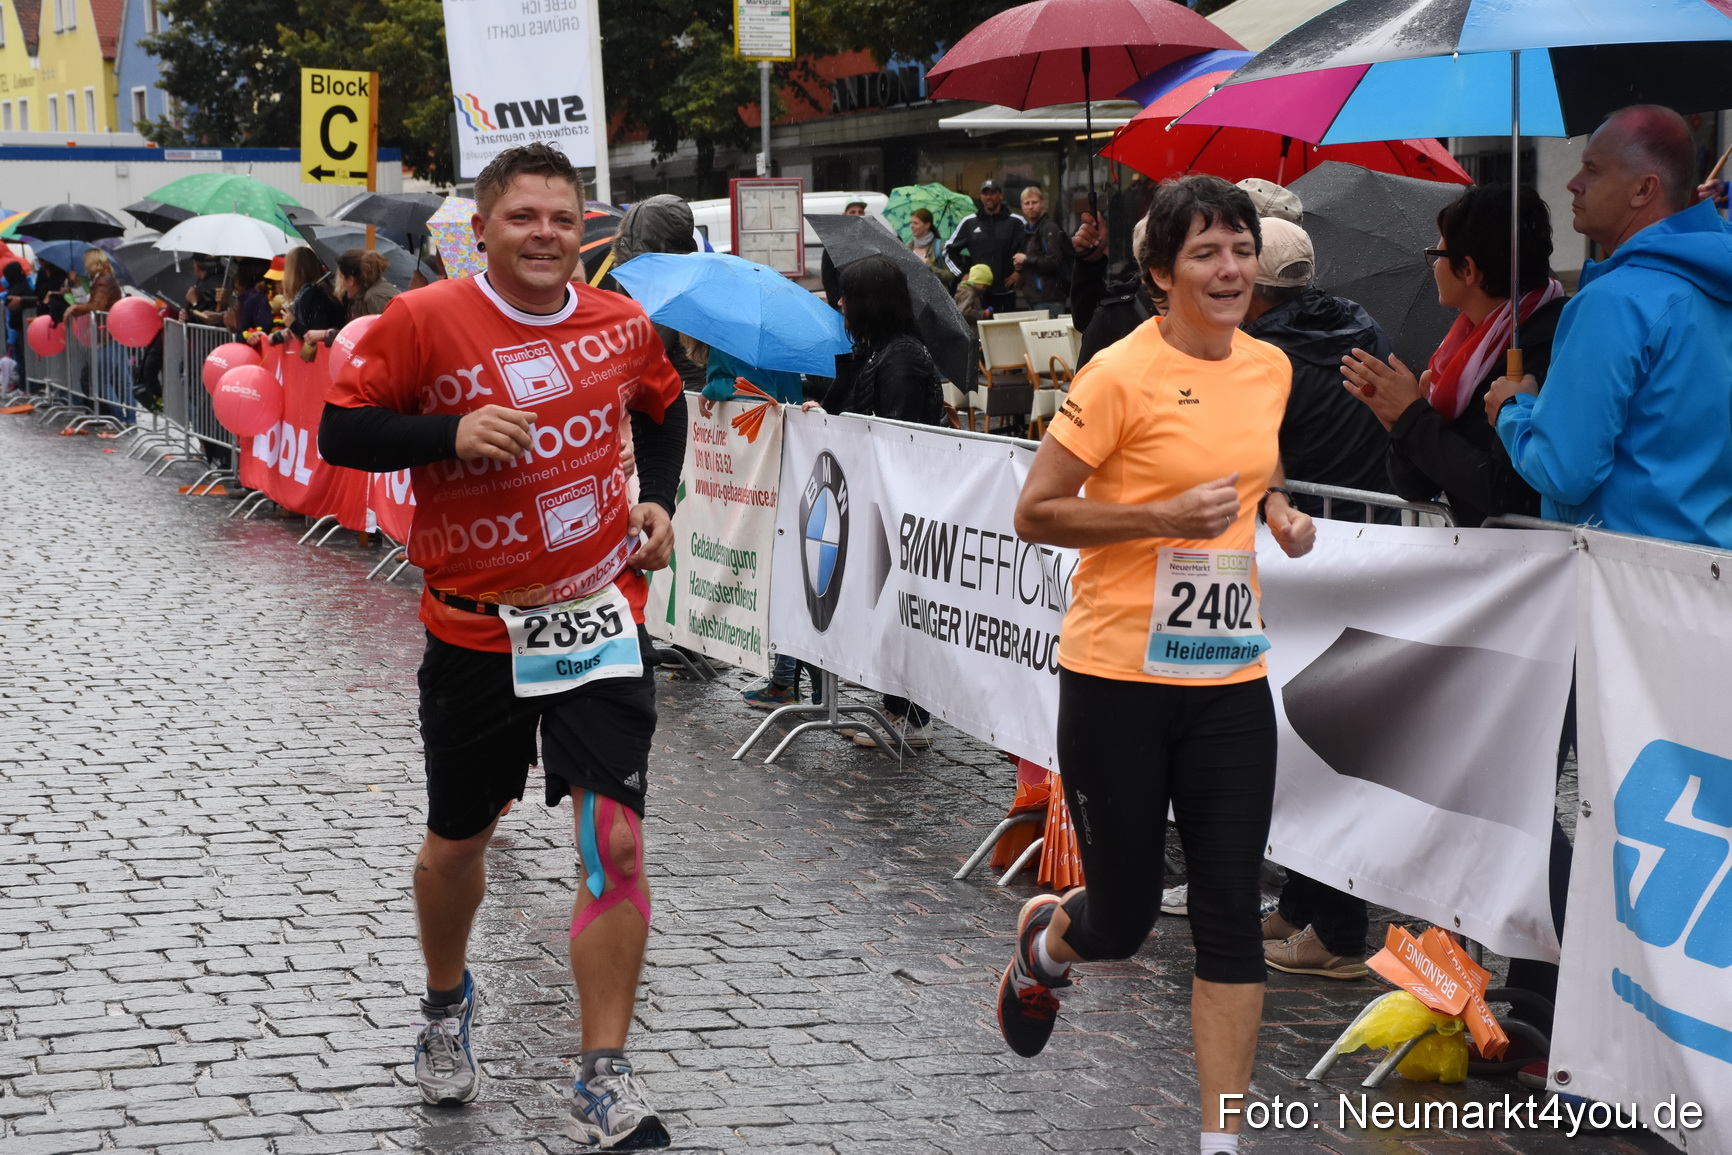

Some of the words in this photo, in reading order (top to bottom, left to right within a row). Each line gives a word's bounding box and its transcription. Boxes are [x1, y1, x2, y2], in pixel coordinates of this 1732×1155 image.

[311, 74, 369, 97] Block
[320, 105, 358, 161] C
[499, 346, 549, 364] raumbox
[1178, 398, 1199, 406] erima
[500, 467, 559, 490] wohnen
[805, 455, 848, 517] BMW
[541, 482, 594, 510] raumbox
[900, 513, 959, 583] BMW
[475, 550, 531, 570] outdoor
[1170, 563, 1211, 572] NeuerMarkt
[1167, 581, 1253, 630] 2402
[524, 603, 624, 648] 2355
[1165, 640, 1260, 660] Heidemarie
[556, 654, 601, 676] Claus
[1405, 942, 1459, 1000] BRANDING
